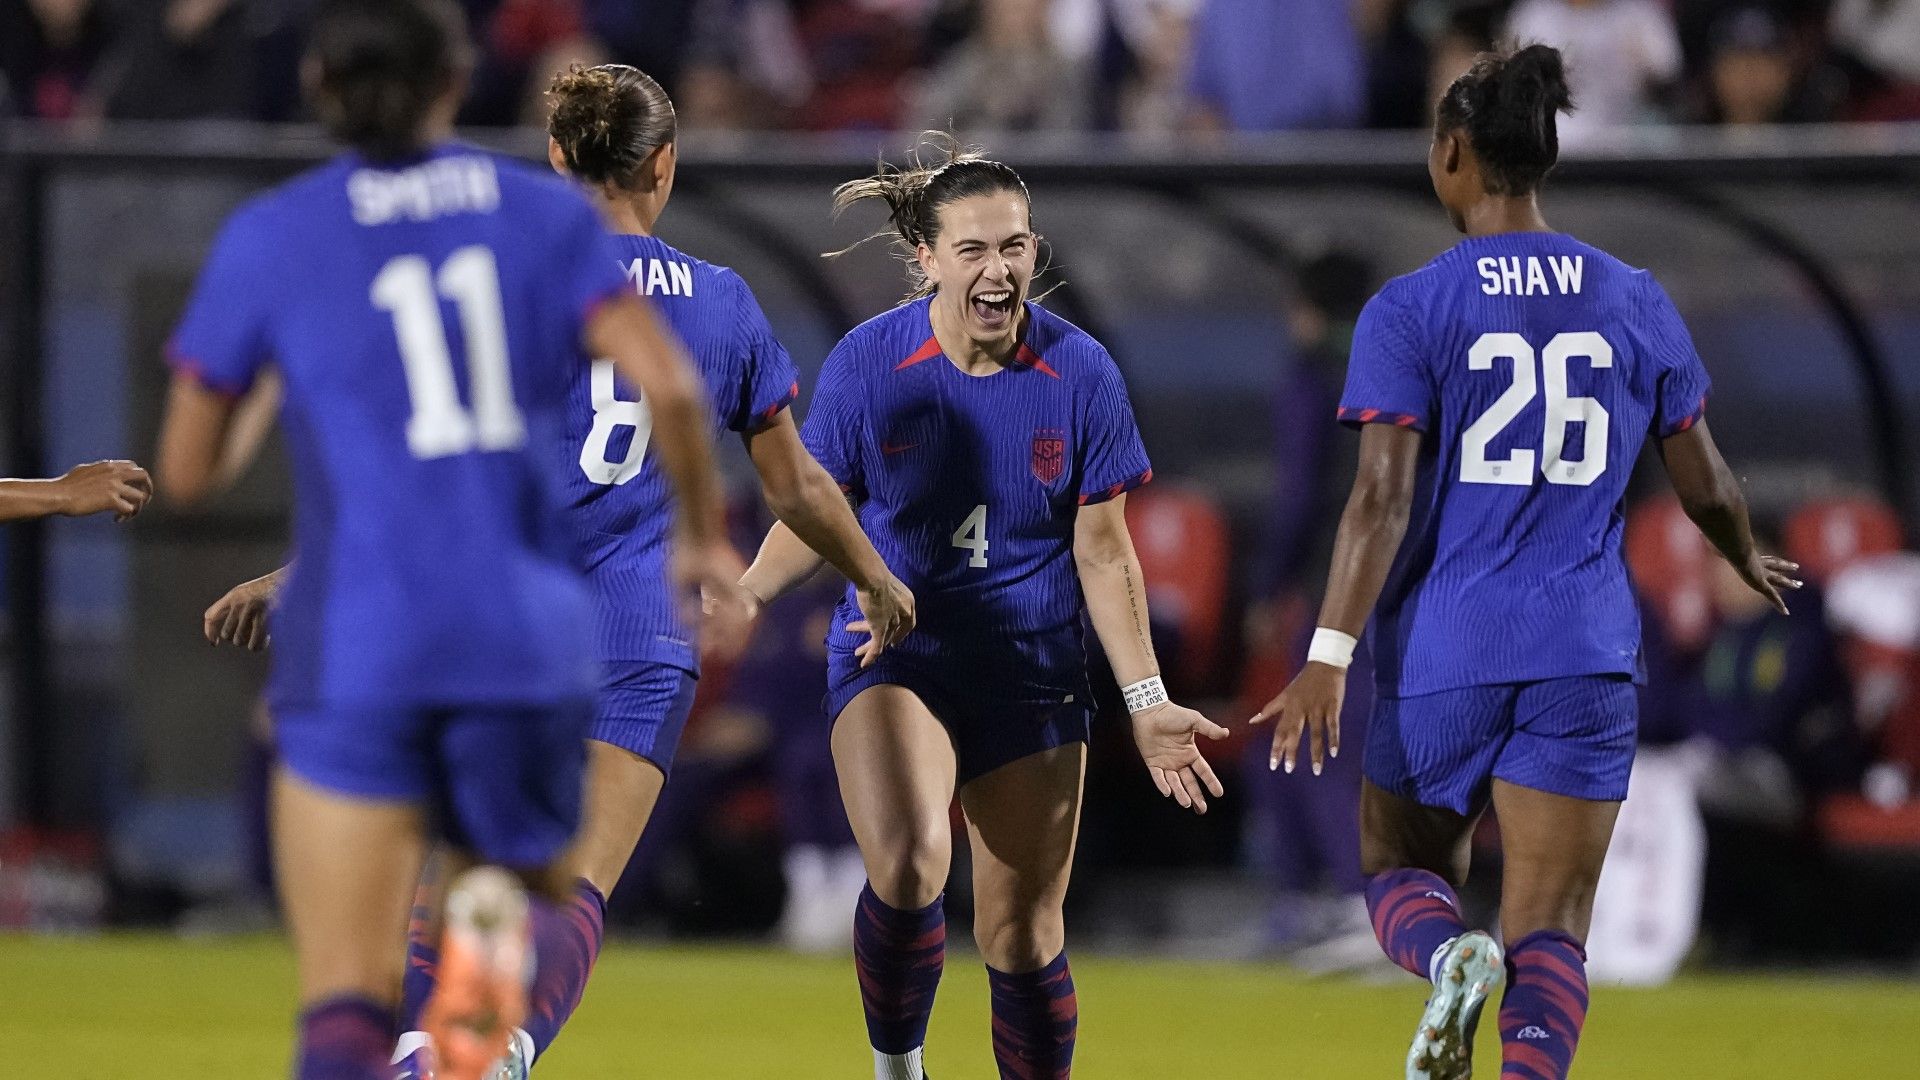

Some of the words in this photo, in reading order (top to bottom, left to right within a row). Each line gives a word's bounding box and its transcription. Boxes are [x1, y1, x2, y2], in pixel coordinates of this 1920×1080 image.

[346, 156, 499, 225] SMITH
[1477, 255, 1583, 296] SHAW
[369, 244, 529, 461] 11
[579, 359, 653, 485] 8
[1459, 331, 1613, 486] 26
[1034, 440, 1063, 458] USA
[952, 505, 988, 568] 4
[1145, 694, 1163, 706] DEUT
